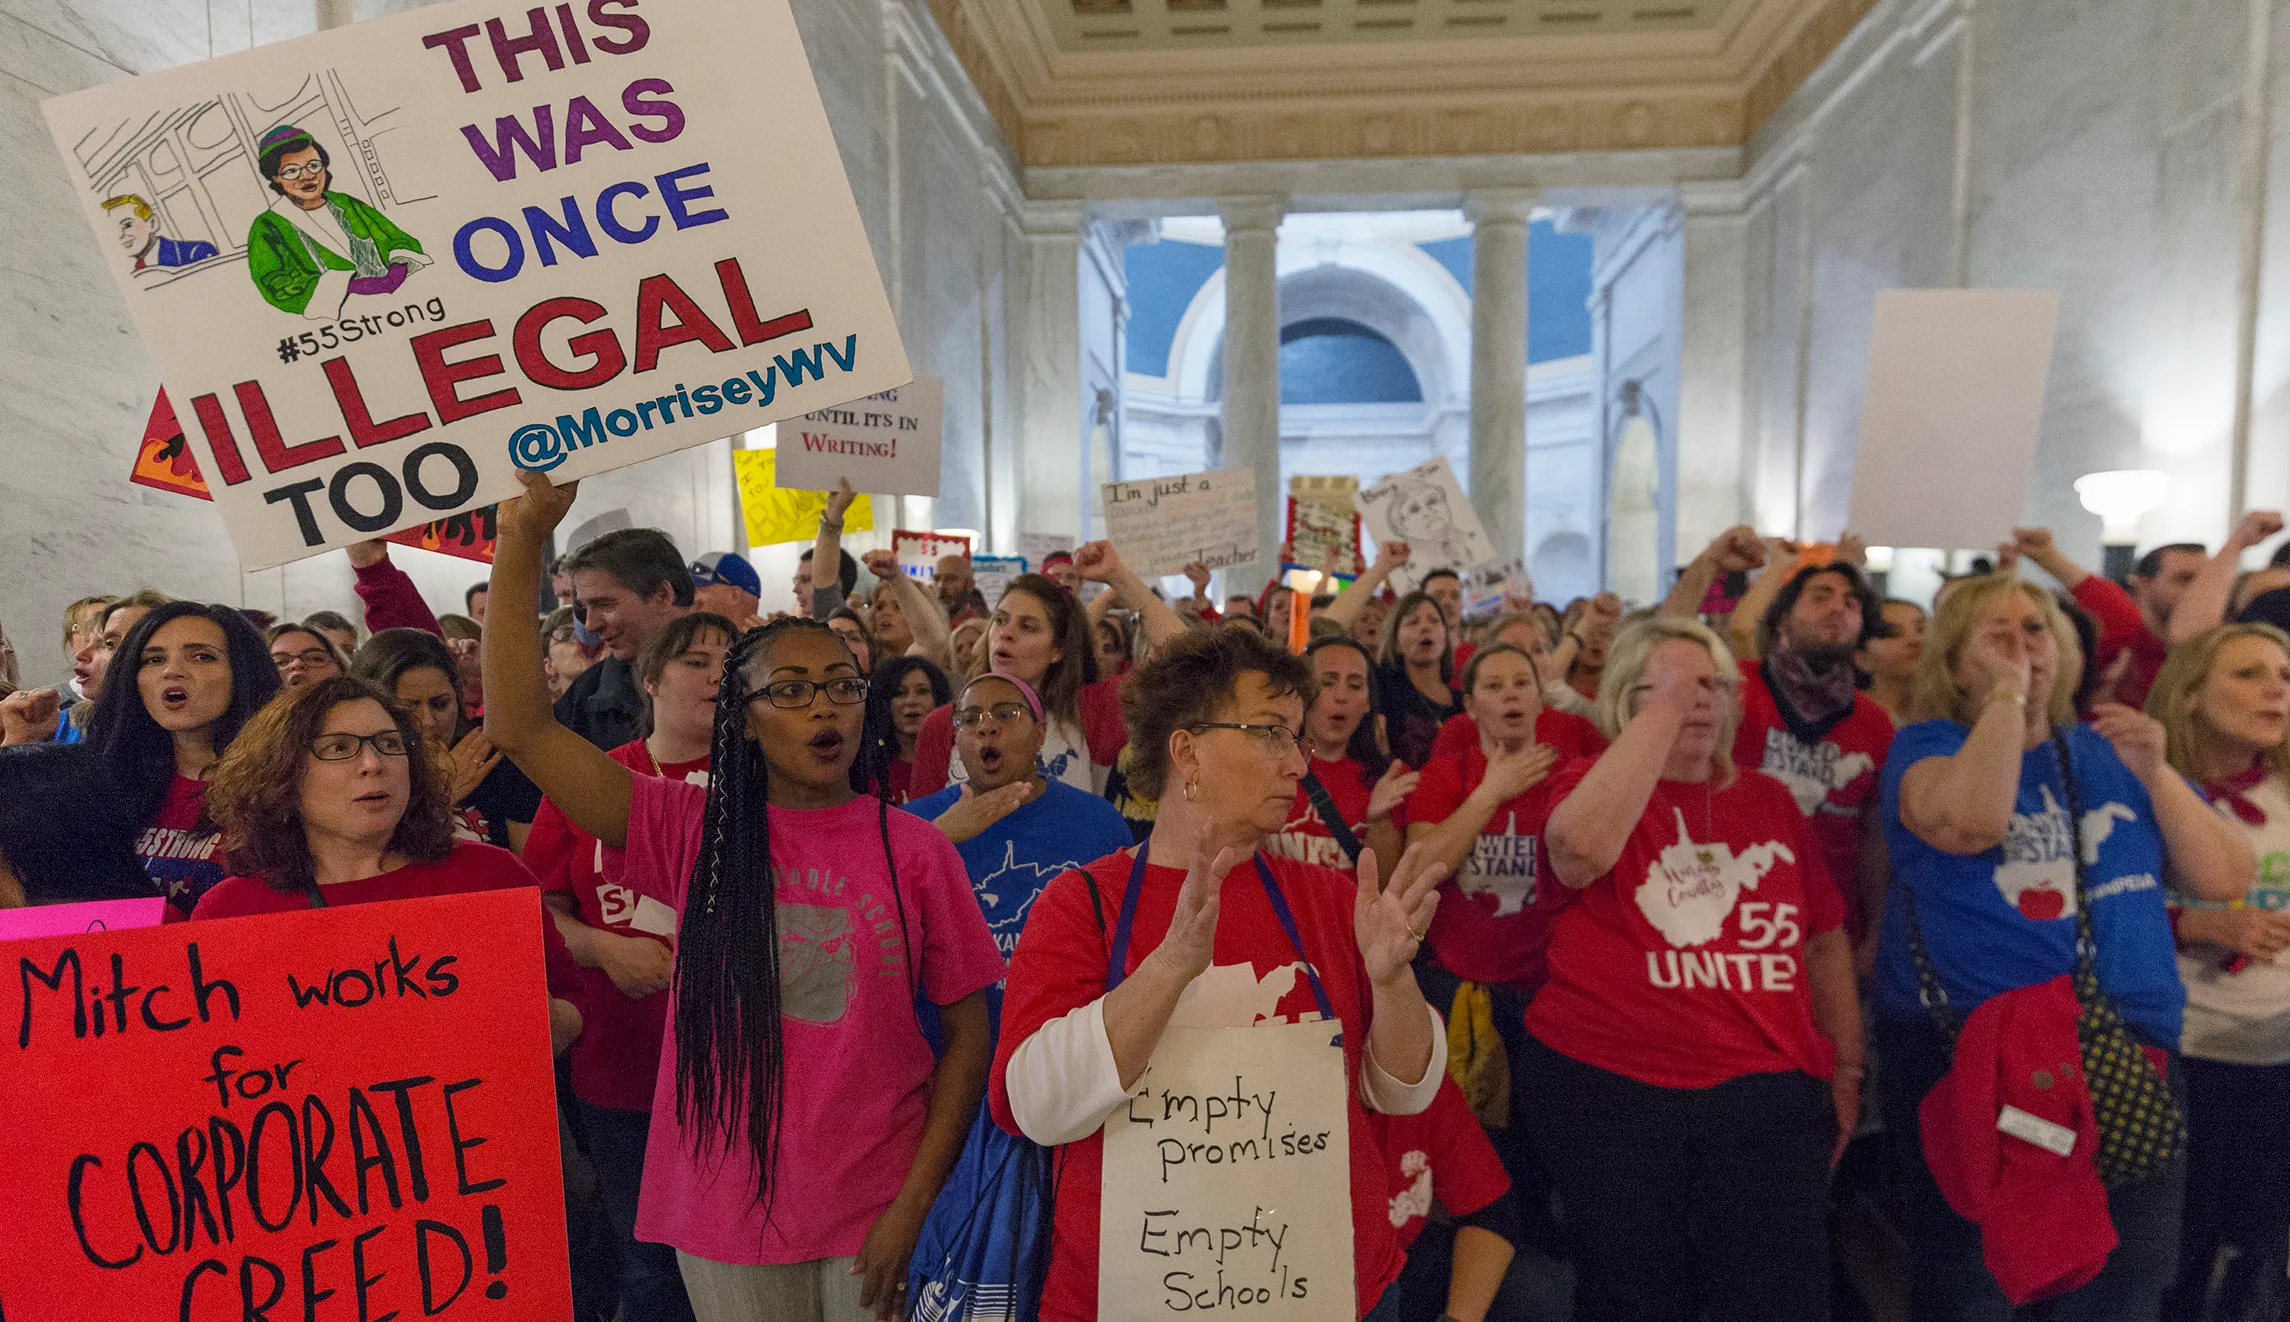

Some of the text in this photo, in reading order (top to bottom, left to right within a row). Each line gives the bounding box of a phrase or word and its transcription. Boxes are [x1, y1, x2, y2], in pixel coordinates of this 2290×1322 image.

[422, 0, 650, 93] THIS
[459, 78, 685, 182] WAS
[453, 162, 729, 282] ONCE
[276, 296, 446, 364] #55Strong
[190, 257, 813, 486] ILLEGAL
[508, 334, 856, 472] @MorriseyWV
[805, 409, 859, 426] UNTIL
[899, 416, 918, 430] IN
[263, 442, 479, 546] TOO
[1107, 475, 1210, 506] I'm just a
[1738, 902, 1799, 949] 55
[19, 935, 459, 1049] Mitch works
[204, 1045, 305, 1107] for
[1130, 1075, 1275, 1139] Empty
[68, 1077, 507, 1269] CORPORATE
[1158, 1123, 1331, 1182] promises
[1140, 1206, 1288, 1272] Empty
[1164, 1265, 1308, 1311] Schools
